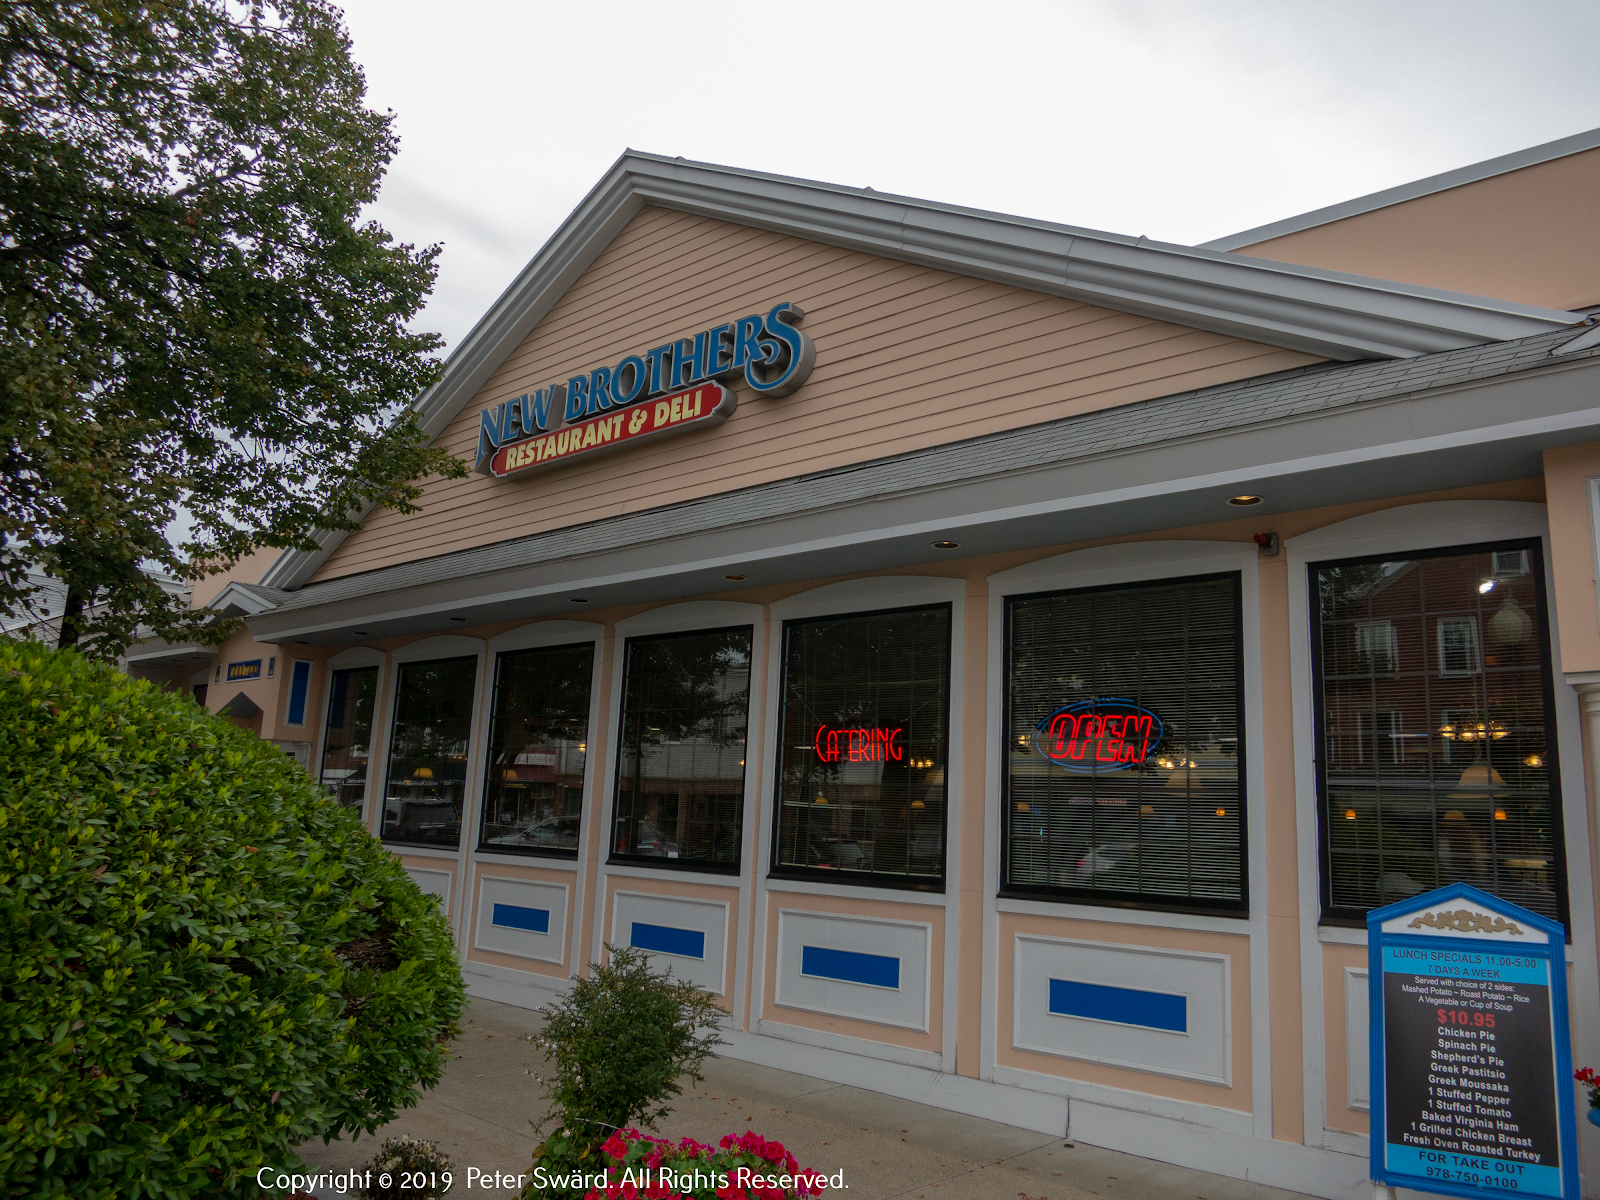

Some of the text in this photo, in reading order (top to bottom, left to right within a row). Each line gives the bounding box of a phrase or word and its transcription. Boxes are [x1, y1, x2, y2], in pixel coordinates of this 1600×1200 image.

[475, 302, 810, 470] NEW BROTHERS
[505, 389, 703, 471] RESTAURANT & DELI
[1048, 713, 1153, 764] OPEN
[1393, 949, 1536, 968] LUNCH SPECIALS 11:00-5:00
[1428, 965, 1500, 978] 7 DAYS A WEEK
[1415, 976, 1438, 985] Served
[1440, 978, 1454, 986] with
[1456, 979, 1477, 989] choice
[1479, 981, 1486, 989] of
[1495, 983, 1515, 992] sides:
[1402, 985, 1428, 994] Mashed
[1430, 987, 1452, 996] Potato
[1460, 990, 1481, 999] Roast
[1483, 991, 1505, 1001] Potato
[1514, 995, 1529, 1003] Rice
[1425, 996, 1459, 1006] Vegetable
[1469, 1000, 1483, 1009] Cup
[1495, 1003, 1513, 1012] Soup
[1437, 1008, 1495, 1028] $10.95
[1438, 1027, 1495, 1040] Chicken Pie
[1438, 1039, 1496, 1053] Spinach Pie
[1431, 1050, 1504, 1066] Shepherd's Pie
[1431, 1062, 1505, 1079] Greek Pastitsio
[1428, 1074, 1509, 1092] Greek Moussaka
[1428, 1087, 1510, 1106] 1 Stuffed Pepper
[1428, 1099, 1511, 1118] 1 Stuffed Tomato
[1422, 1111, 1519, 1132] Baked Virginia Ham
[1411, 1122, 1532, 1147] 1 Grilled Chicken Breast
[1404, 1133, 1540, 1163] Fresh Oven Roasted Turkey
[1419, 1151, 1525, 1176] FOR TAKE OUT
[1427, 1167, 1518, 1189] 978-750-0100
